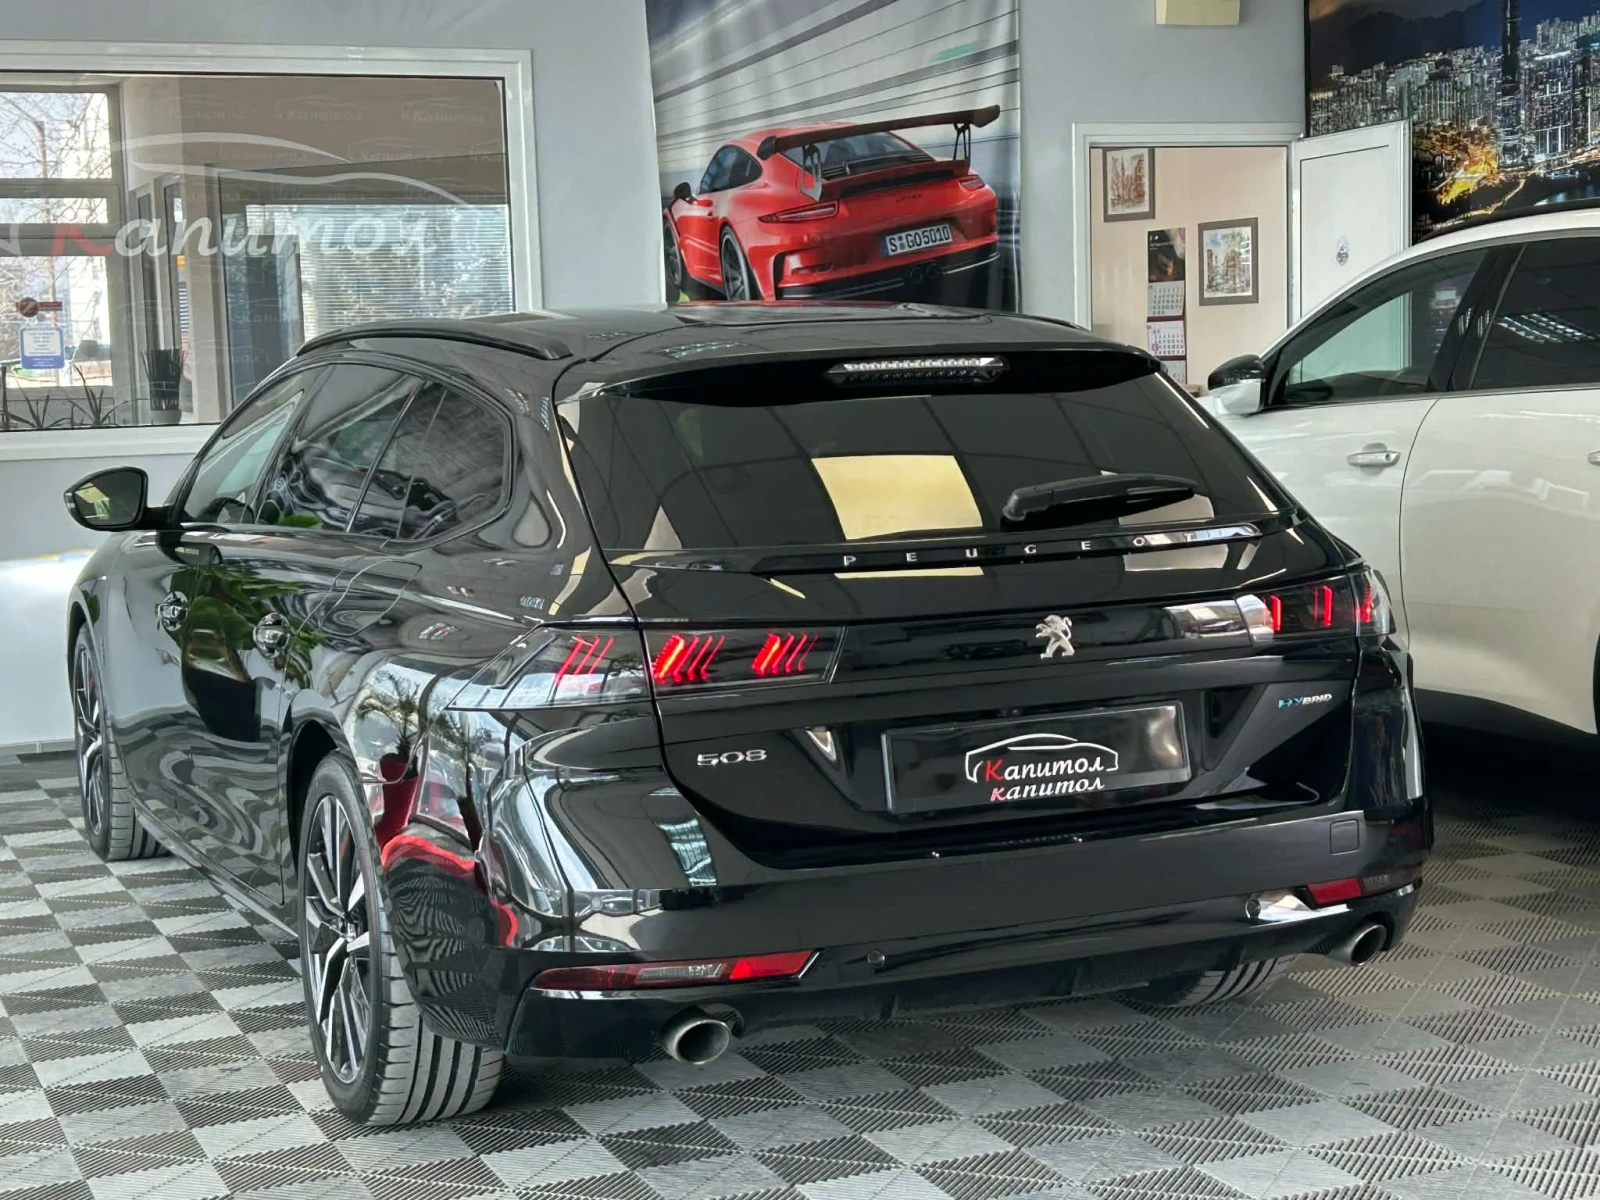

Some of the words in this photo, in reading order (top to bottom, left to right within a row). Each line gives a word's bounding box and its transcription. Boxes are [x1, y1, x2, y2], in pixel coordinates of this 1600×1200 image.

[843, 533, 1194, 567] PEUGEOT
[1278, 693, 1333, 709] HYBRID
[697, 749, 767, 766] 508
[985, 757, 1105, 782] Капитол
